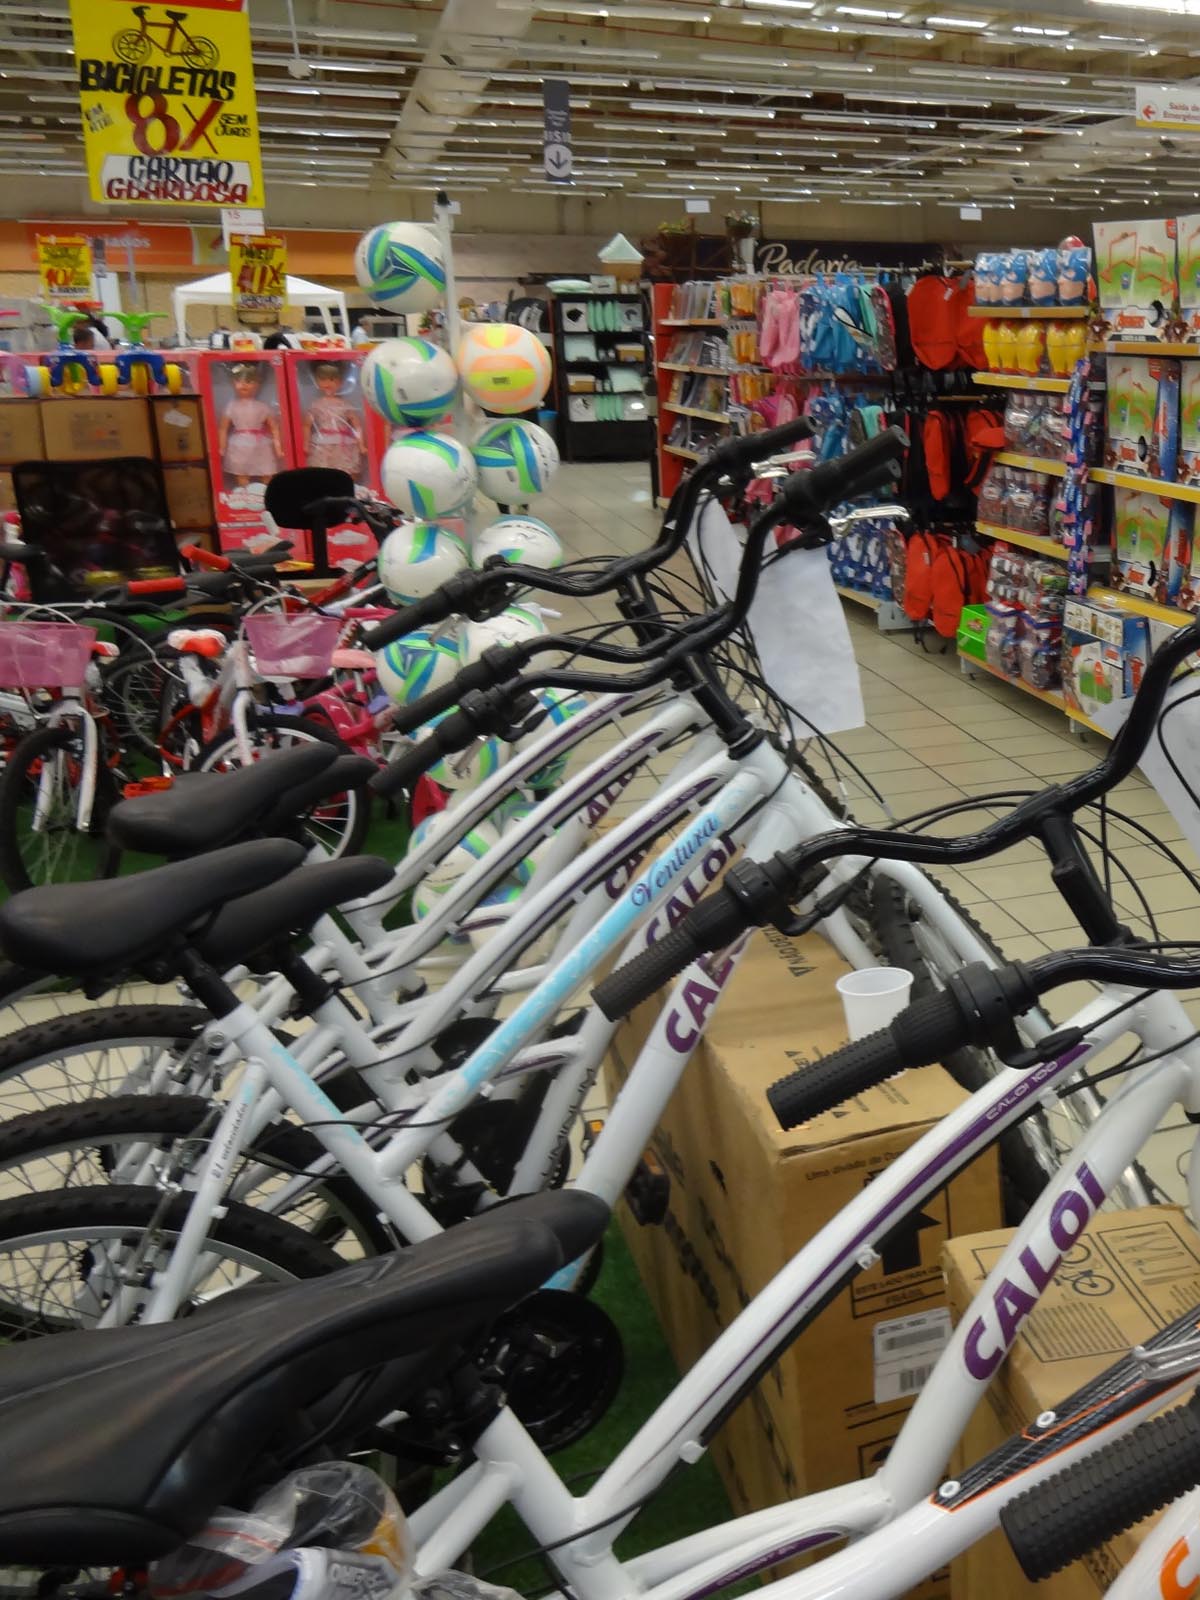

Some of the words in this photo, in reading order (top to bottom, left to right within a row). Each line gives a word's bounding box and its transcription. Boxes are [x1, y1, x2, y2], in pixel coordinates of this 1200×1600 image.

[80, 59, 236, 101] BICICLETAS
[218, 113, 249, 125] SEM
[757, 243, 862, 278] Padaria
[986, 1084, 1031, 1121] CALOI
[1031, 1061, 1059, 1083] 100
[963, 1161, 1107, 1380] CALOI
